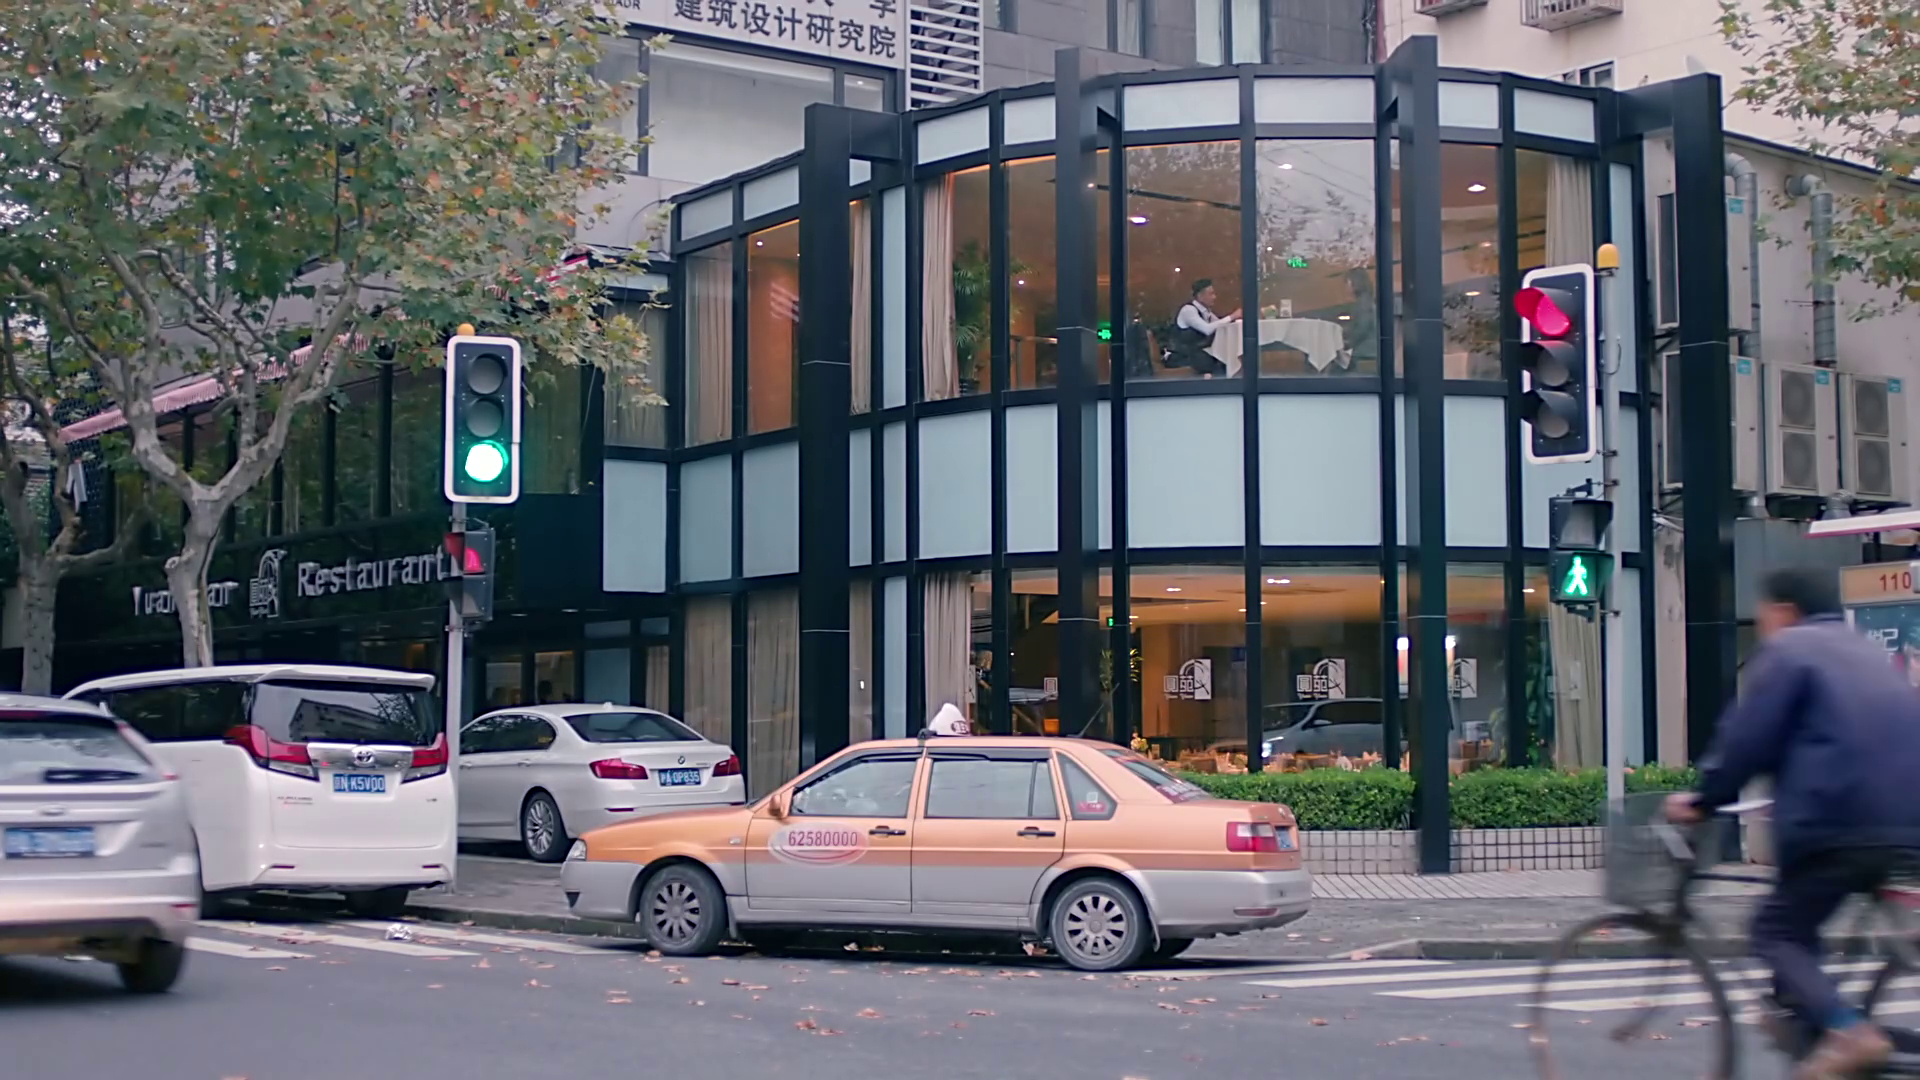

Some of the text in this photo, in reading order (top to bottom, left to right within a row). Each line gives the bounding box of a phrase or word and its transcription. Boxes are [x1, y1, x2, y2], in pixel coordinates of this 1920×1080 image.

[674, 0, 896, 59] 建筑设计研究院
[297, 545, 445, 598] Restaurant
[1879, 571, 1912, 591] 110
[788, 831, 858, 847] 62580000
